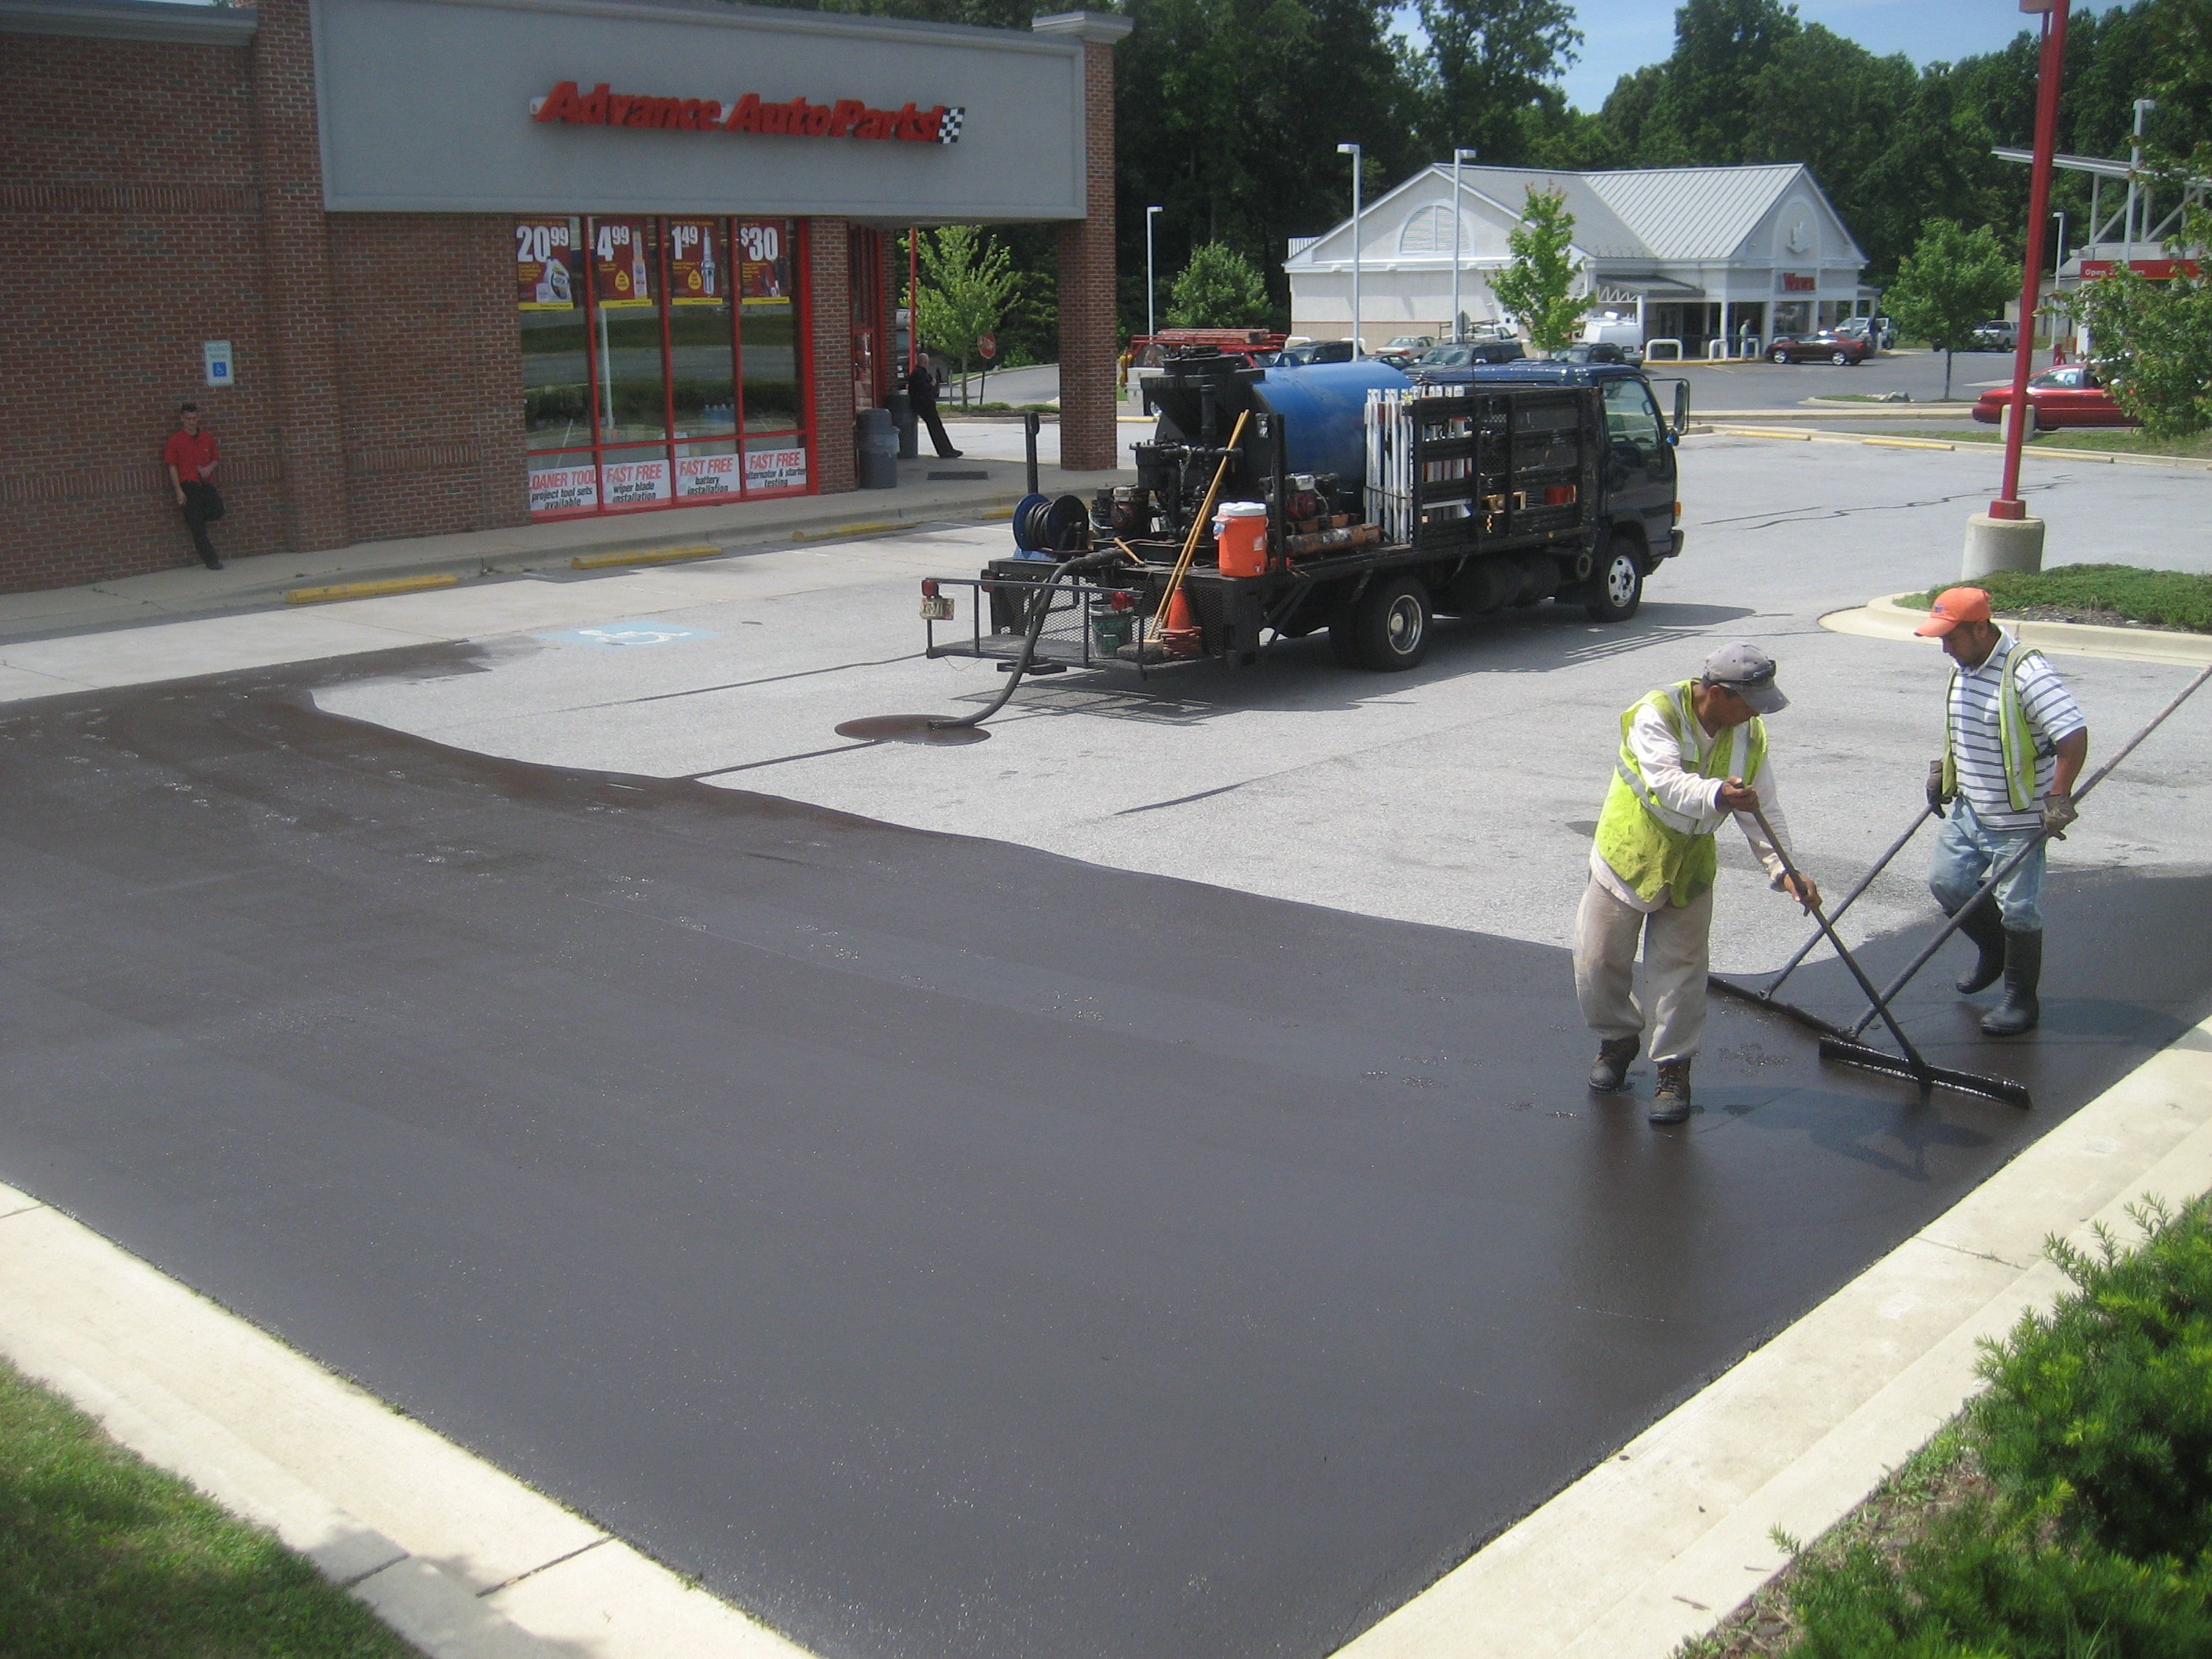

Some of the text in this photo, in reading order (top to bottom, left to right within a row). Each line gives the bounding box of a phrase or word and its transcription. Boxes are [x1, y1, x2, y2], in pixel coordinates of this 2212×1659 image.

[535, 80, 722, 132] Advance
[680, 457, 733, 475] FAST FREE
[750, 452, 800, 470] FAST FREE
[606, 463, 663, 483] FAST FREE
[695, 475, 720, 485] battery
[764, 478, 789, 489] testing
[613, 481, 655, 493] wiper blade
[687, 485, 729, 496] installation
[532, 486, 593, 503] project tool sets
[613, 492, 656, 504] installation
[544, 497, 581, 510] available
